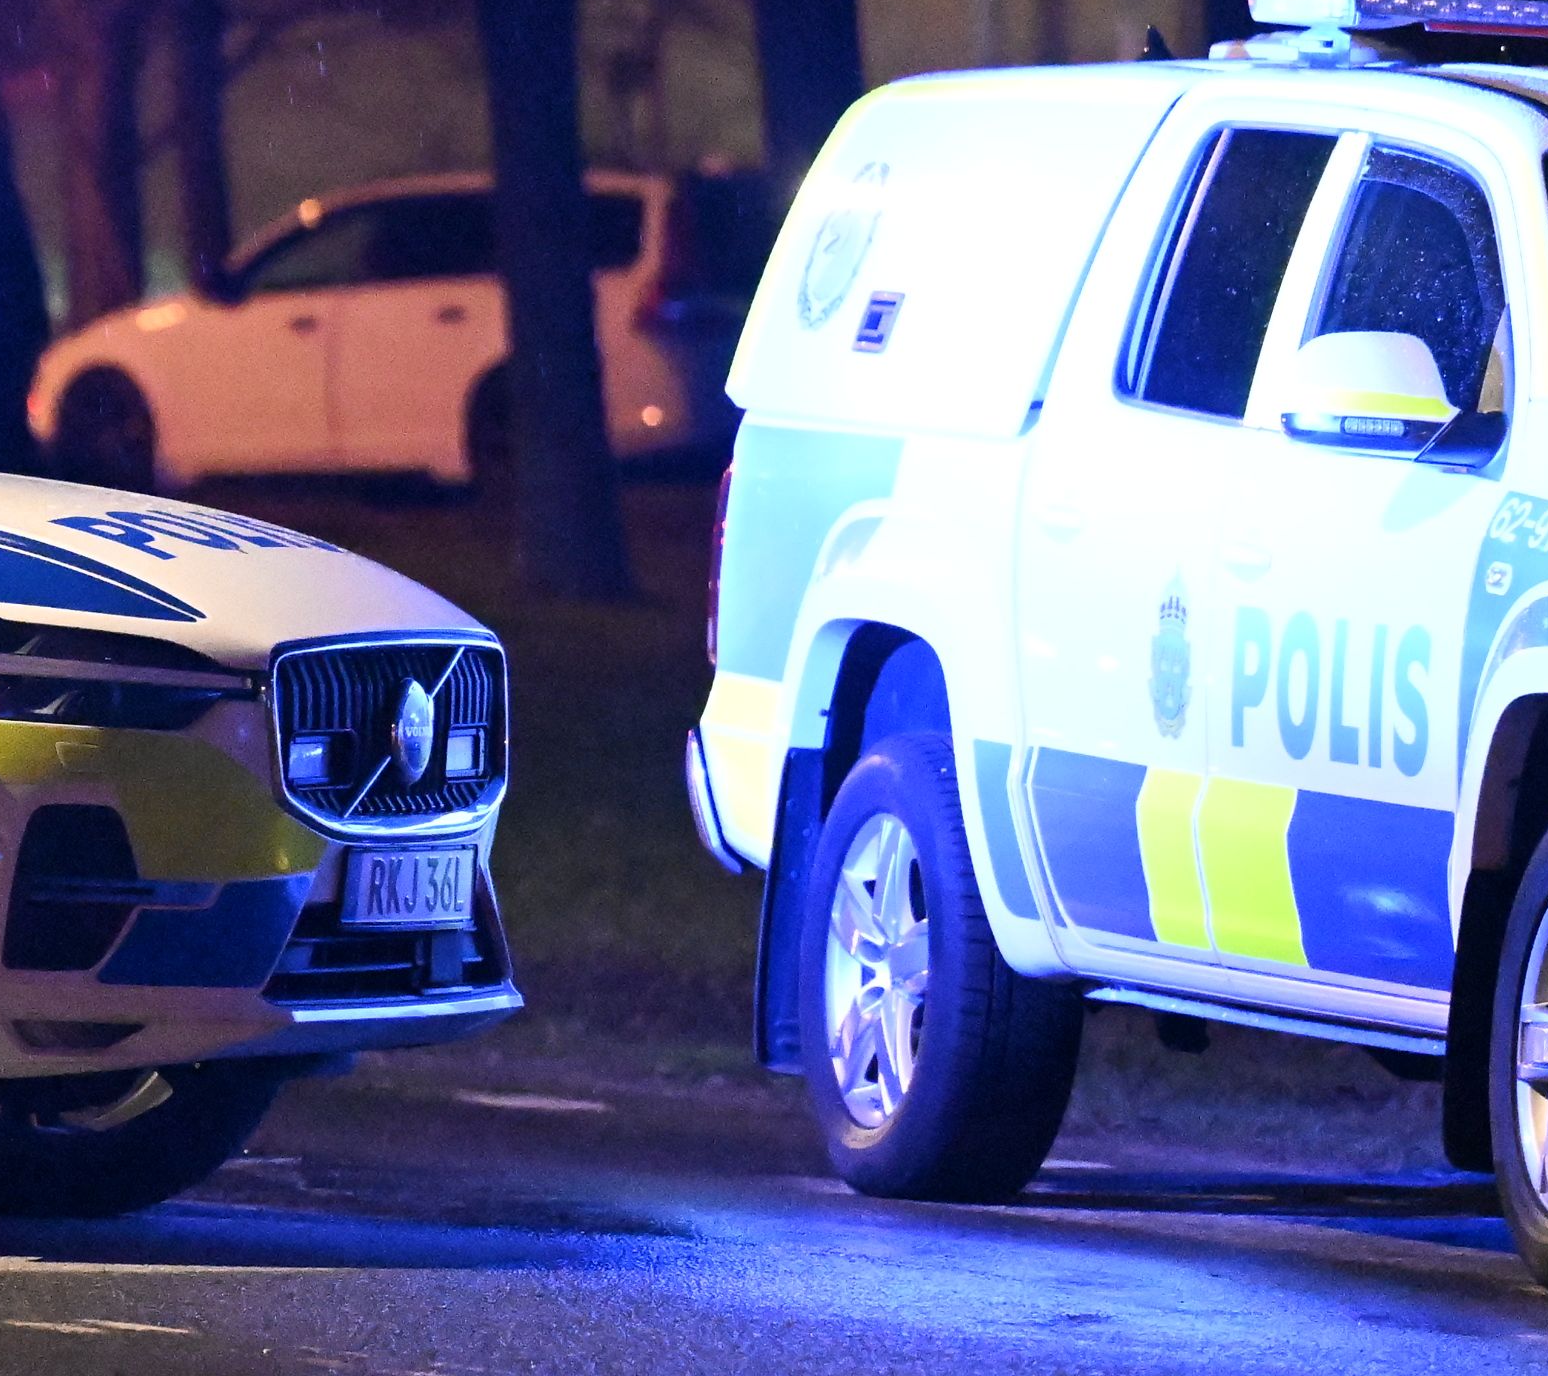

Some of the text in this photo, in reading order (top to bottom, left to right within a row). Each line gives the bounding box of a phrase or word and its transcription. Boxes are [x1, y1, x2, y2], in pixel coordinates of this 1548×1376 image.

[1230, 604, 1432, 778] POLIS
[367, 855, 465, 915] RKJ 36L
